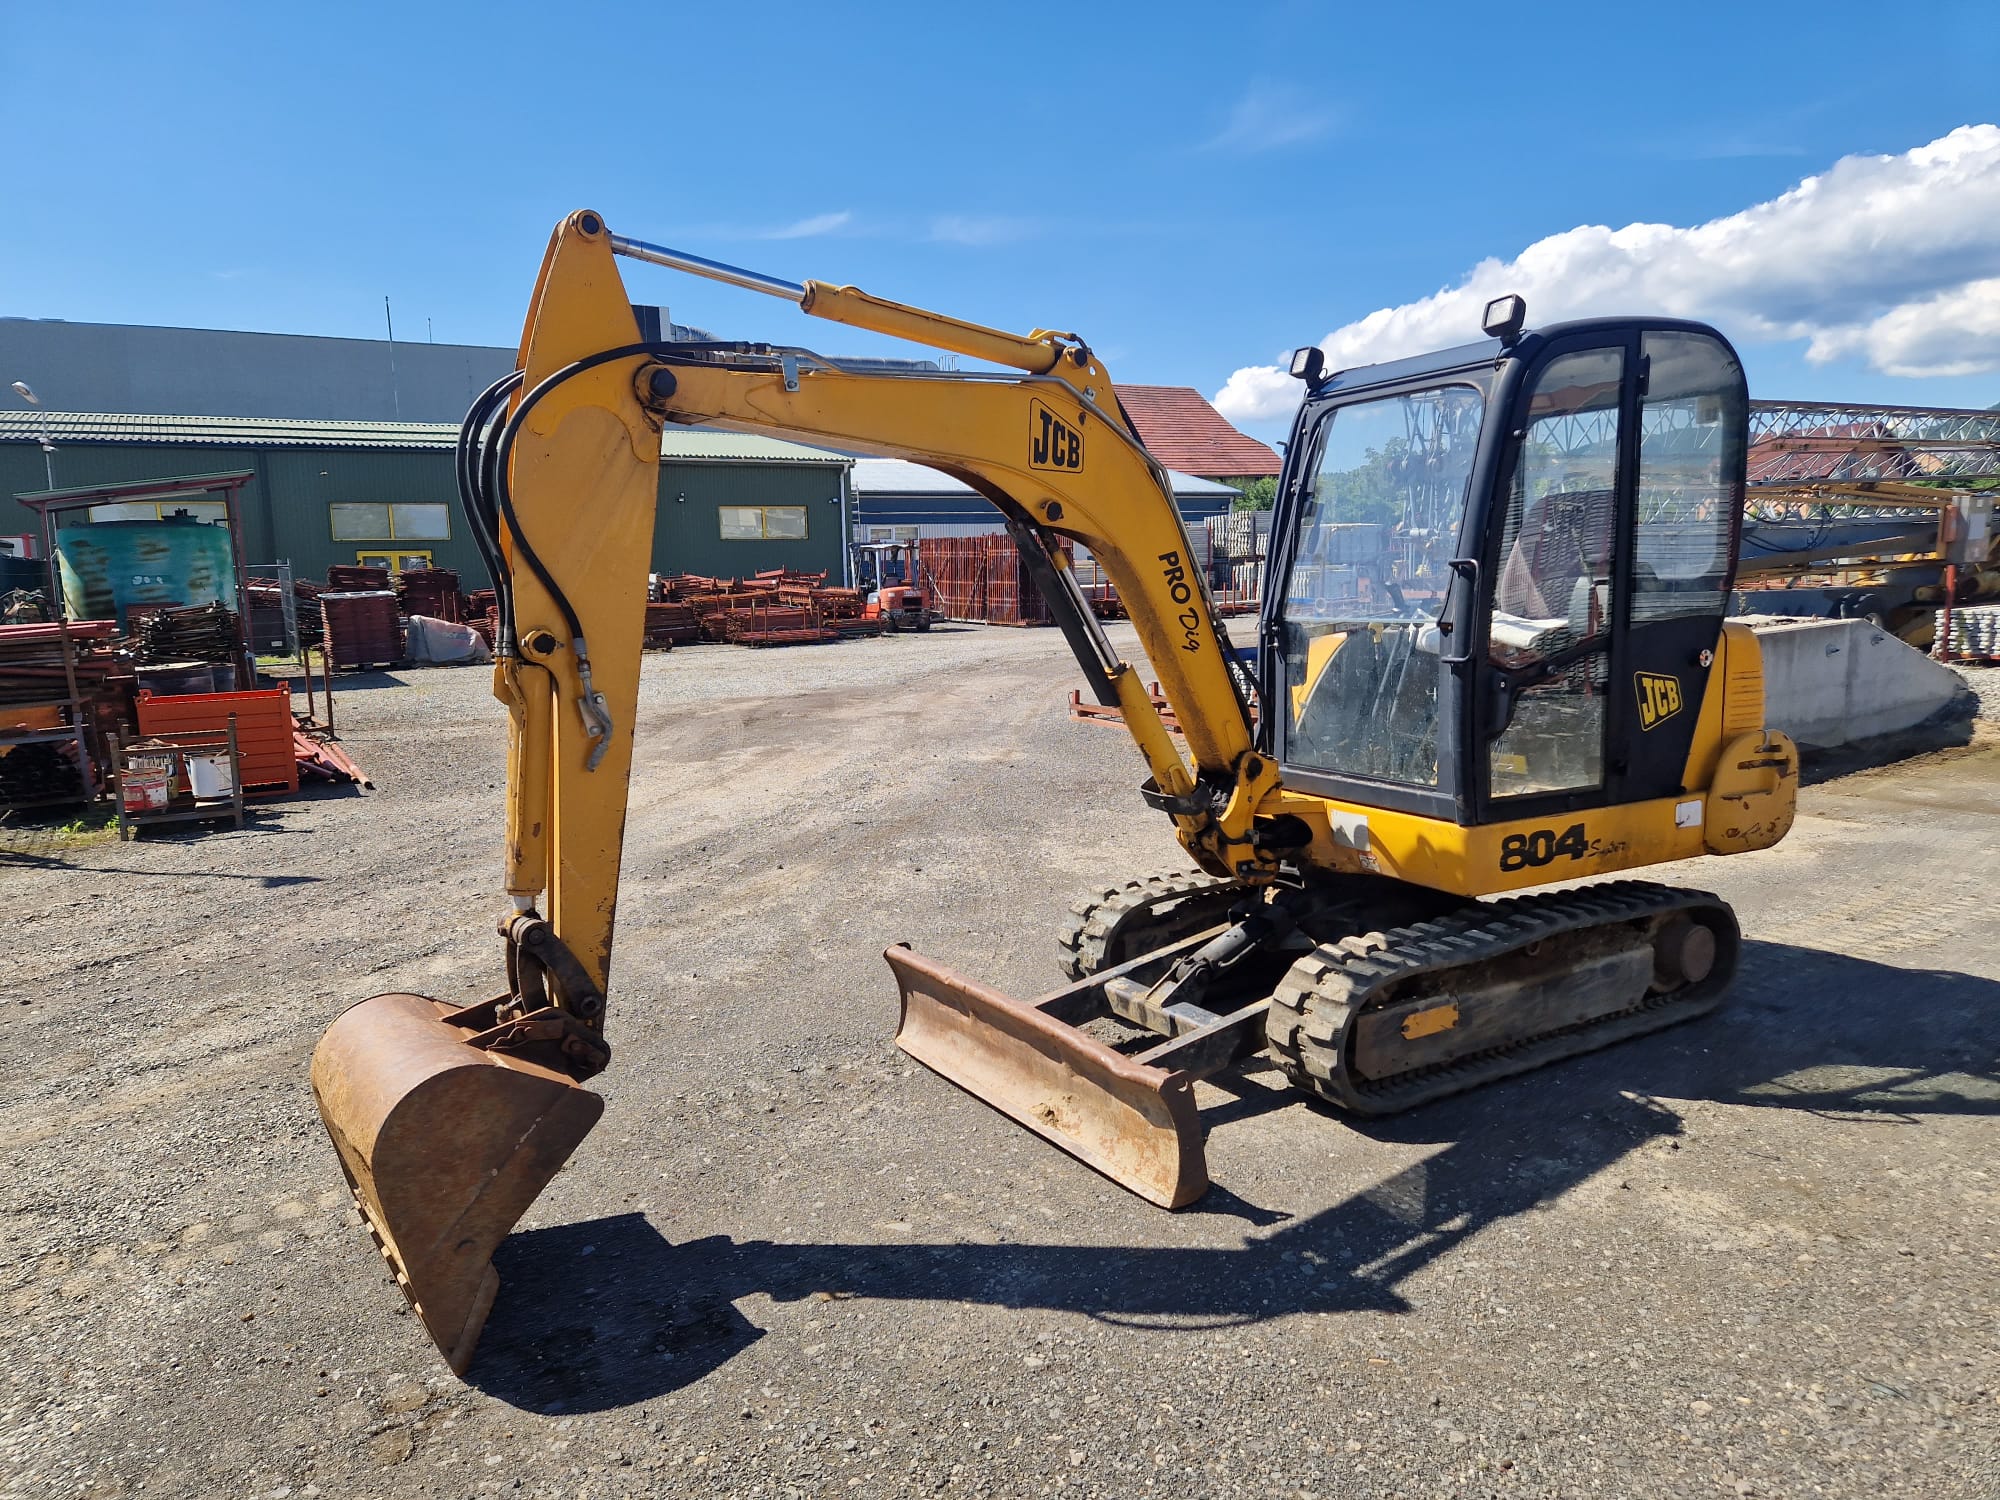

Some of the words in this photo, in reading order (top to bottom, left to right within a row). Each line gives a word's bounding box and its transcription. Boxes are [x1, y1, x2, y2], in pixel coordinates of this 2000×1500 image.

[1033, 408, 1080, 468] JCB
[1158, 551, 1191, 604] PRO
[1179, 607, 1200, 653] Dig
[1641, 677, 1679, 725] JCB
[1499, 823, 1588, 872] 804
